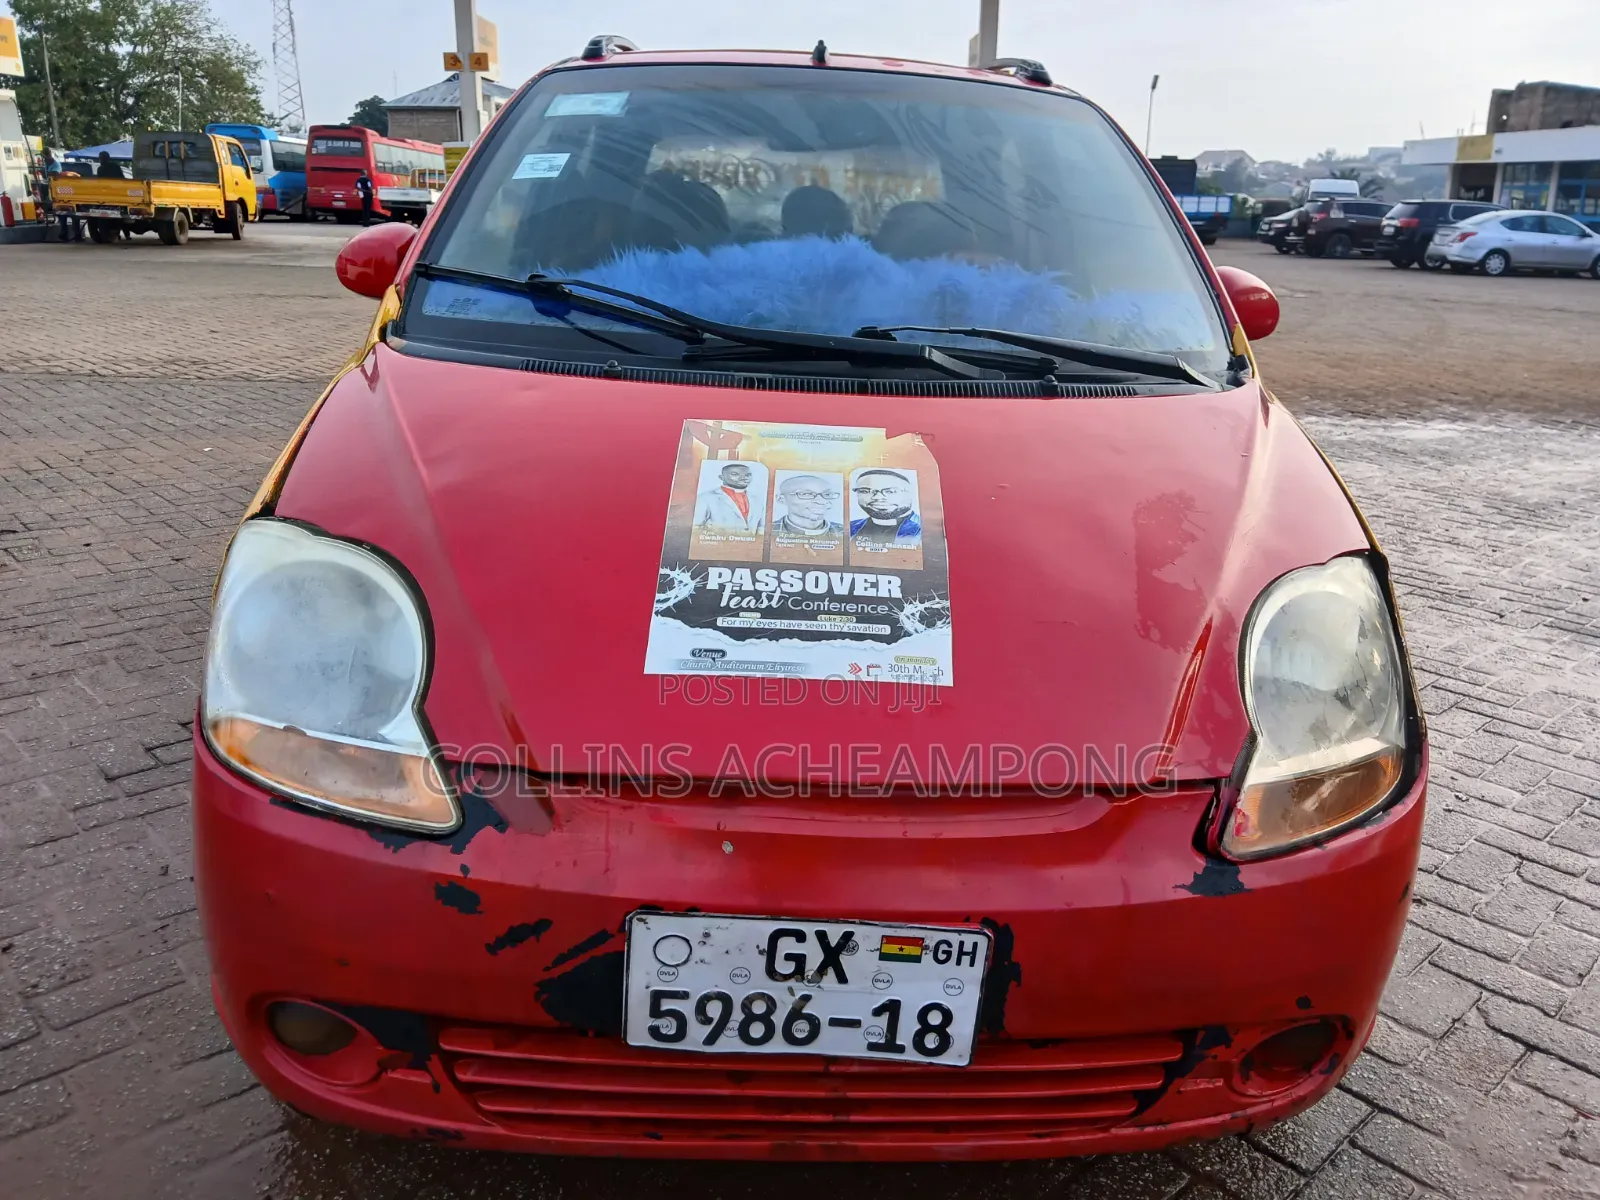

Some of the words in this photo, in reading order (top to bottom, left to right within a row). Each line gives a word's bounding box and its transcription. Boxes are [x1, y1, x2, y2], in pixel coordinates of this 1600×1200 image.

[474, 56, 483, 67] 4
[707, 566, 903, 599] PASSOVER
[720, 582, 786, 610] Feast
[787, 597, 889, 615] Conference
[721, 618, 737, 626] For
[739, 620, 754, 629] my
[756, 620, 778, 630] eyes
[780, 619, 803, 629] have
[805, 622, 827, 630] seen
[829, 622, 845, 633] thy
[846, 622, 887, 634] savation
[693, 649, 723, 659] Venue
[680, 660, 712, 669] Church
[712, 661, 765, 671] Auditorium
[887, 663, 910, 674] 30th
[912, 664, 944, 677] Mch
[764, 928, 855, 985] GX
[932, 939, 979, 968] GH
[647, 988, 954, 1057] 5986-18
